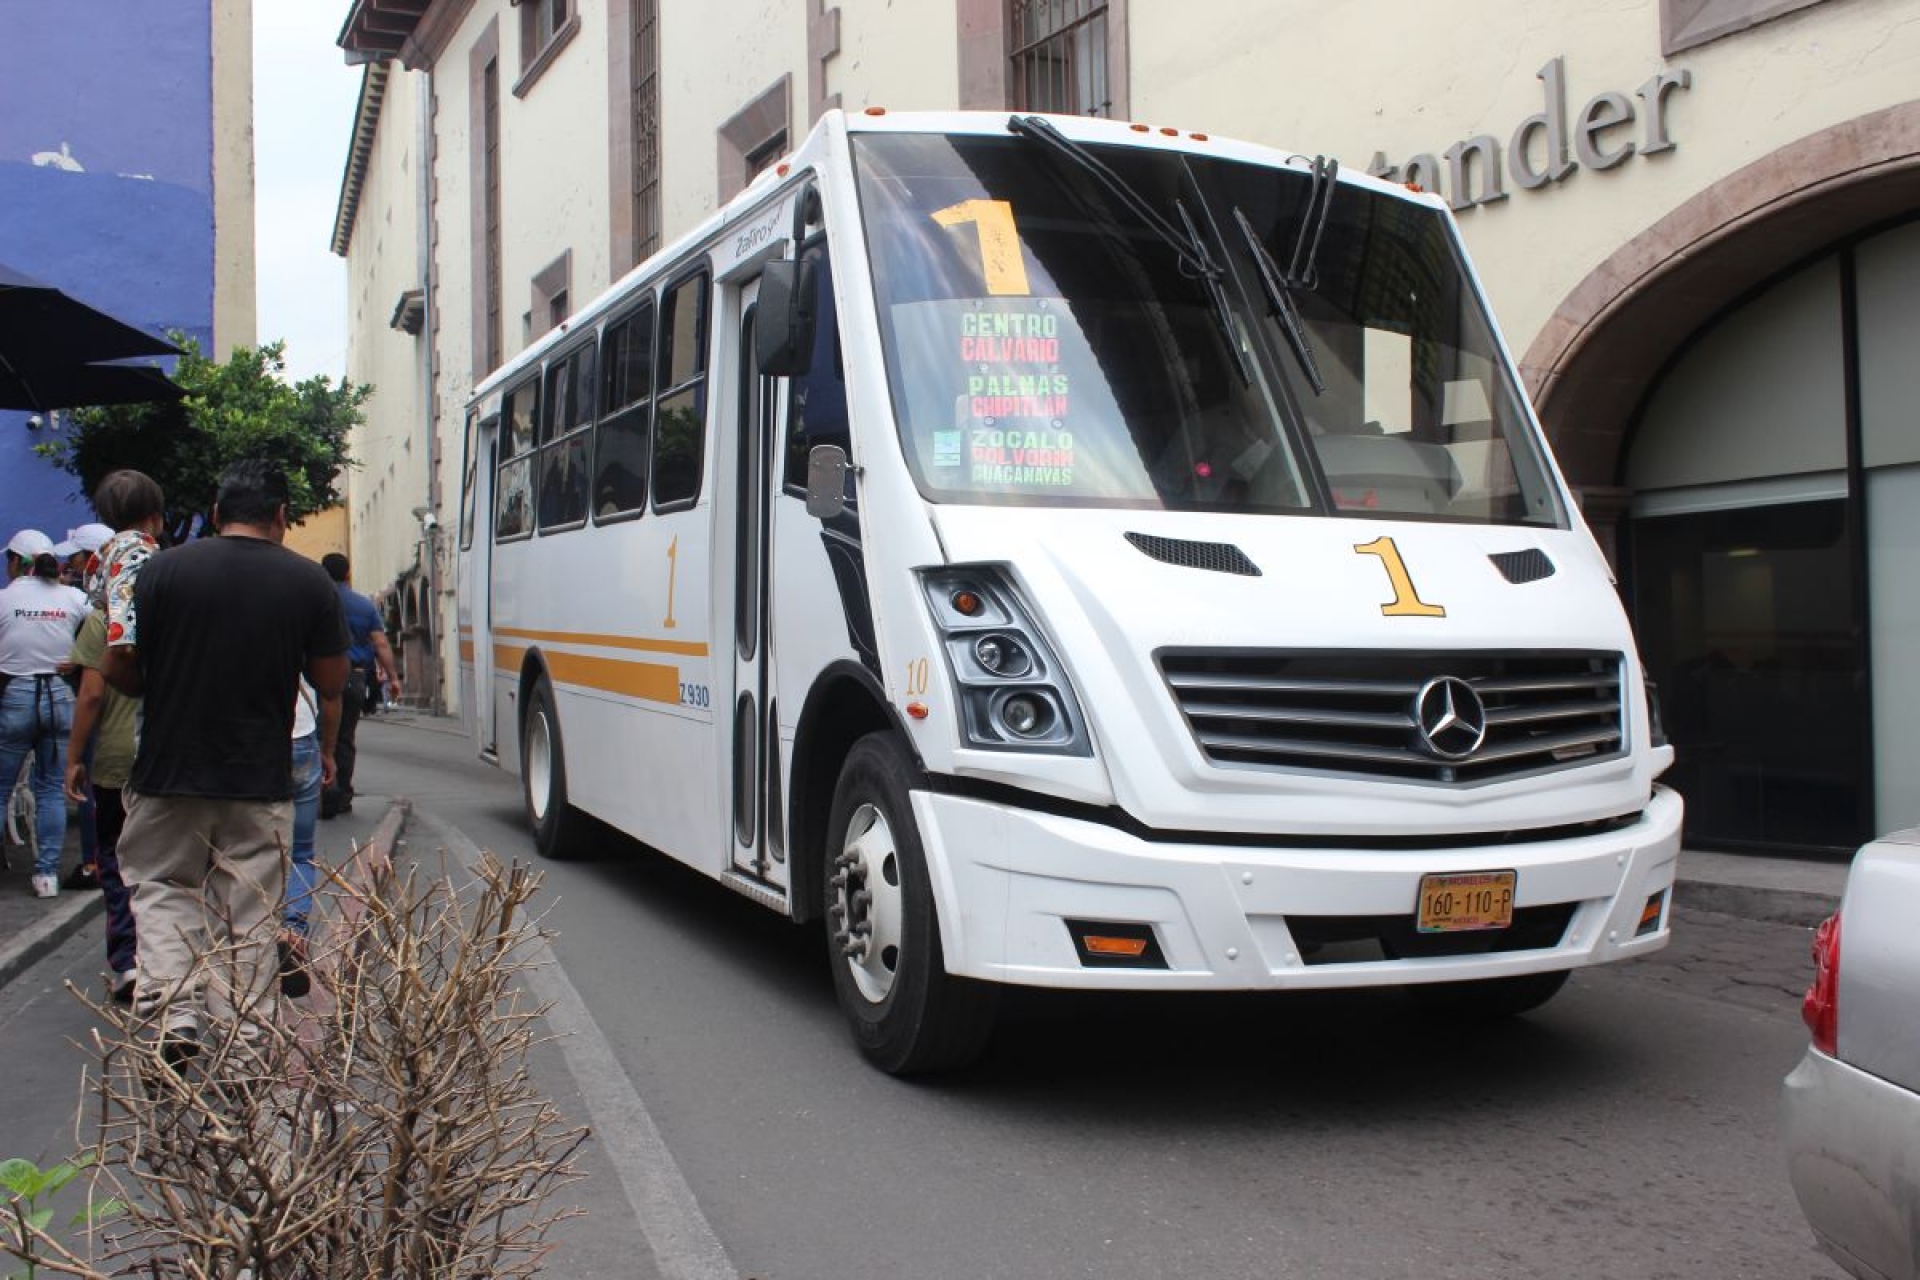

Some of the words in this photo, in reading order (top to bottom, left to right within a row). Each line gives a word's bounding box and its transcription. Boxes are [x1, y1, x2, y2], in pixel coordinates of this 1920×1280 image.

[930, 199, 1030, 295] 1
[962, 312, 1058, 337] CENTRO
[961, 336, 1060, 363] CALVARIO
[969, 374, 1069, 397] PALMAS
[972, 430, 1074, 450] ZOCALO
[972, 463, 1073, 486] GUACAMAYAS
[663, 533, 678, 629] 1
[1353, 535, 1447, 618] 1
[907, 657, 929, 695] 10
[1427, 889, 1511, 916] 160-110-P
